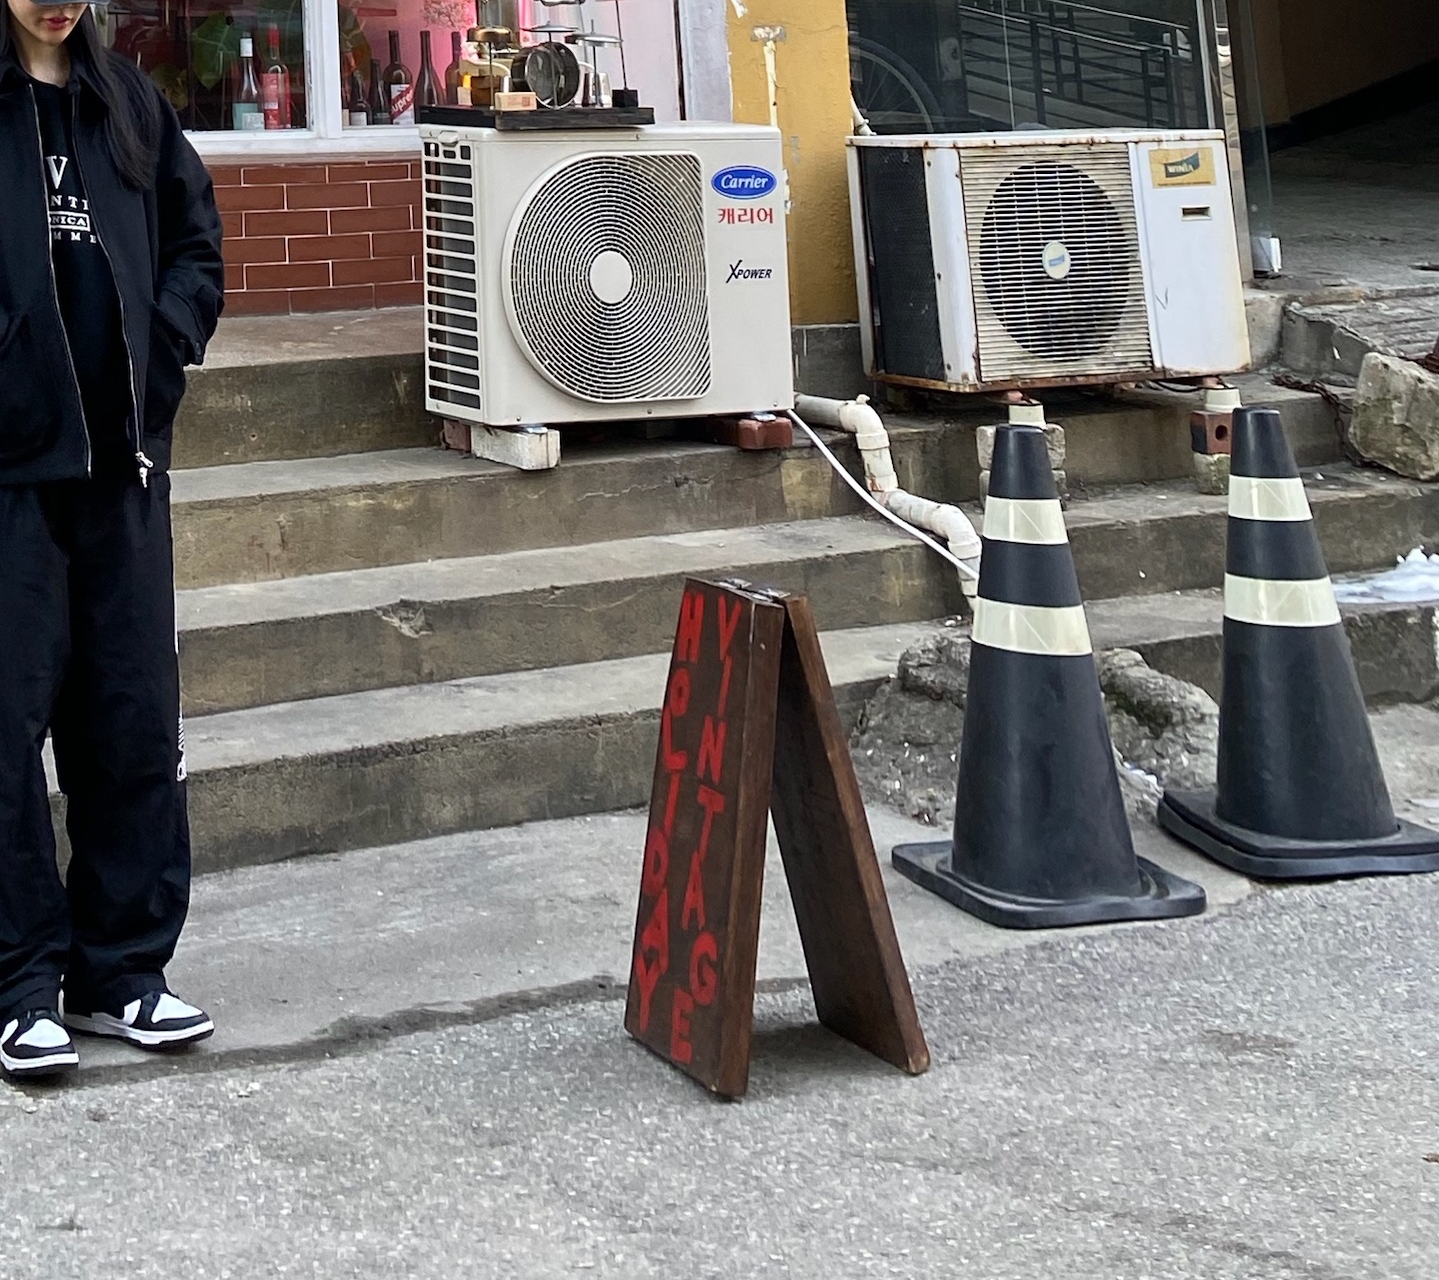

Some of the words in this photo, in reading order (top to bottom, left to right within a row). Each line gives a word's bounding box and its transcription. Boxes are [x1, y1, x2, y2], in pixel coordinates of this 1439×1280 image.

[45, 155, 68, 190] V
[720, 174, 769, 189] Carrier
[717, 207, 774, 225] 캐리어
[635, 590, 705, 1033] HOLIDAY
[670, 594, 742, 1065] VINTAGE
